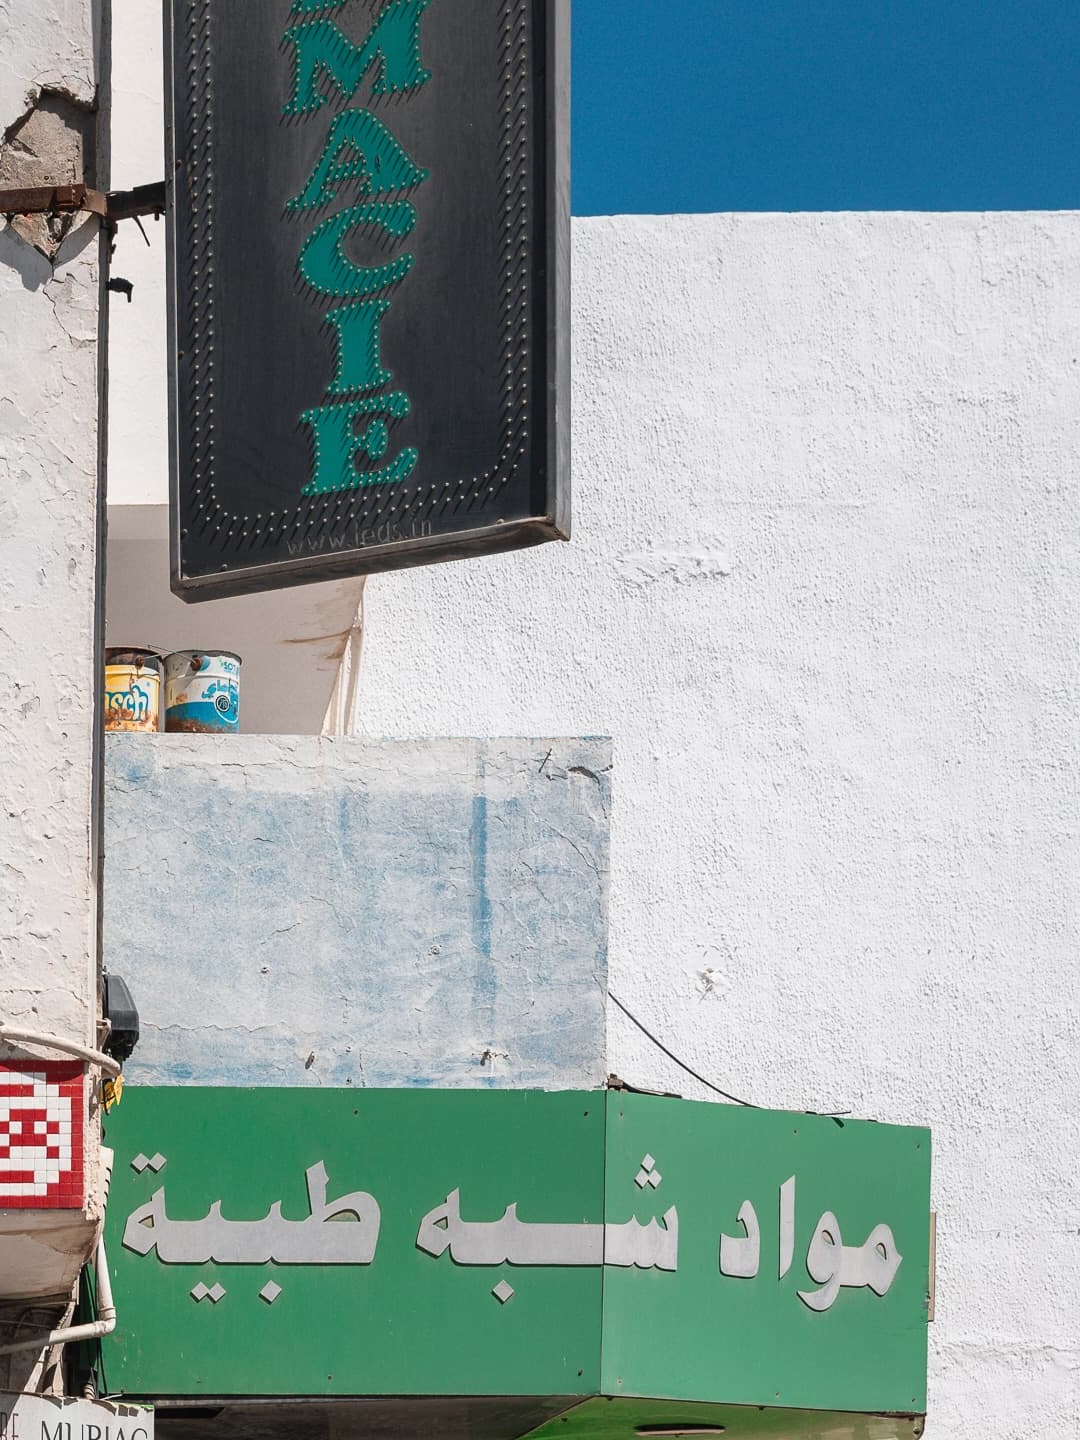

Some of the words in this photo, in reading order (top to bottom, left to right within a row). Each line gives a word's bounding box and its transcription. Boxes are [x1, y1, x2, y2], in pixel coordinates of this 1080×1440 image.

[281, 0, 434, 496] MACIE
[121, 1152, 382, 1306] طبية
[415, 1153, 679, 1306] شبه
[720, 1174, 903, 1312] مواد
